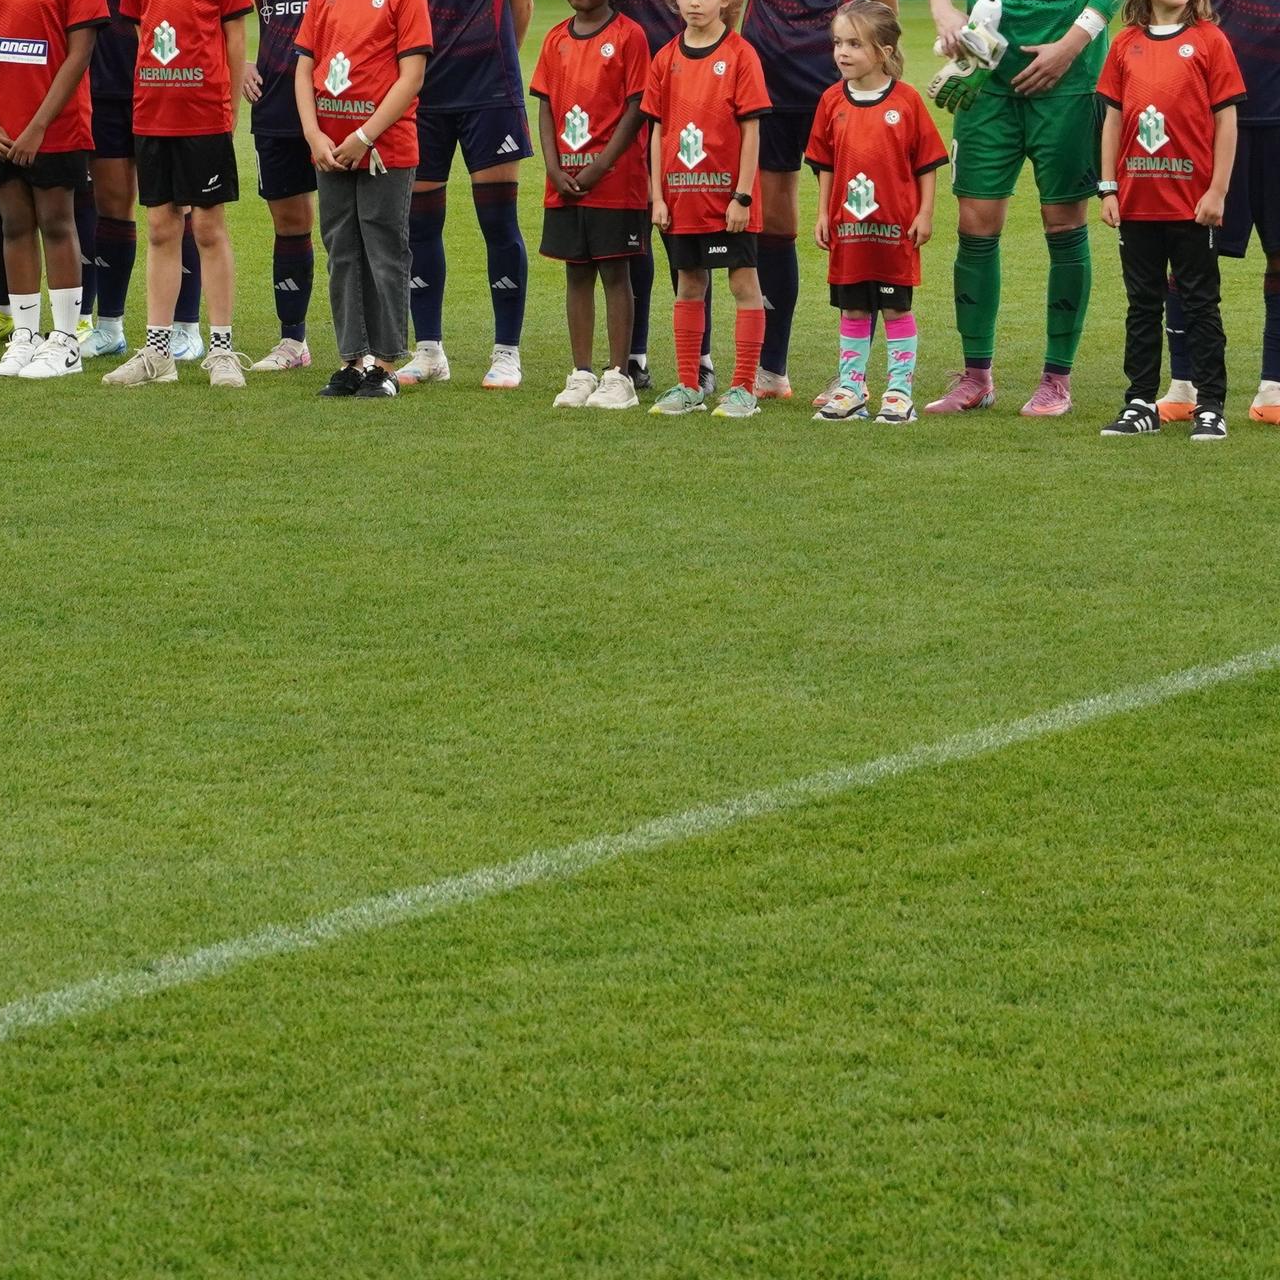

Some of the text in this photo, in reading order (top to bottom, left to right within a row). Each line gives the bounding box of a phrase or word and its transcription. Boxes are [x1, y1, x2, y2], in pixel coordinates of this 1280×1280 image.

[275, 1, 309, 16] SIG
[138, 67, 204, 81] HERMANS
[1125, 156, 1194, 174] HERMANS
[665, 171, 732, 186] HERMANS
[707, 246, 728, 254] JAKO
[879, 286, 895, 294] AKO
